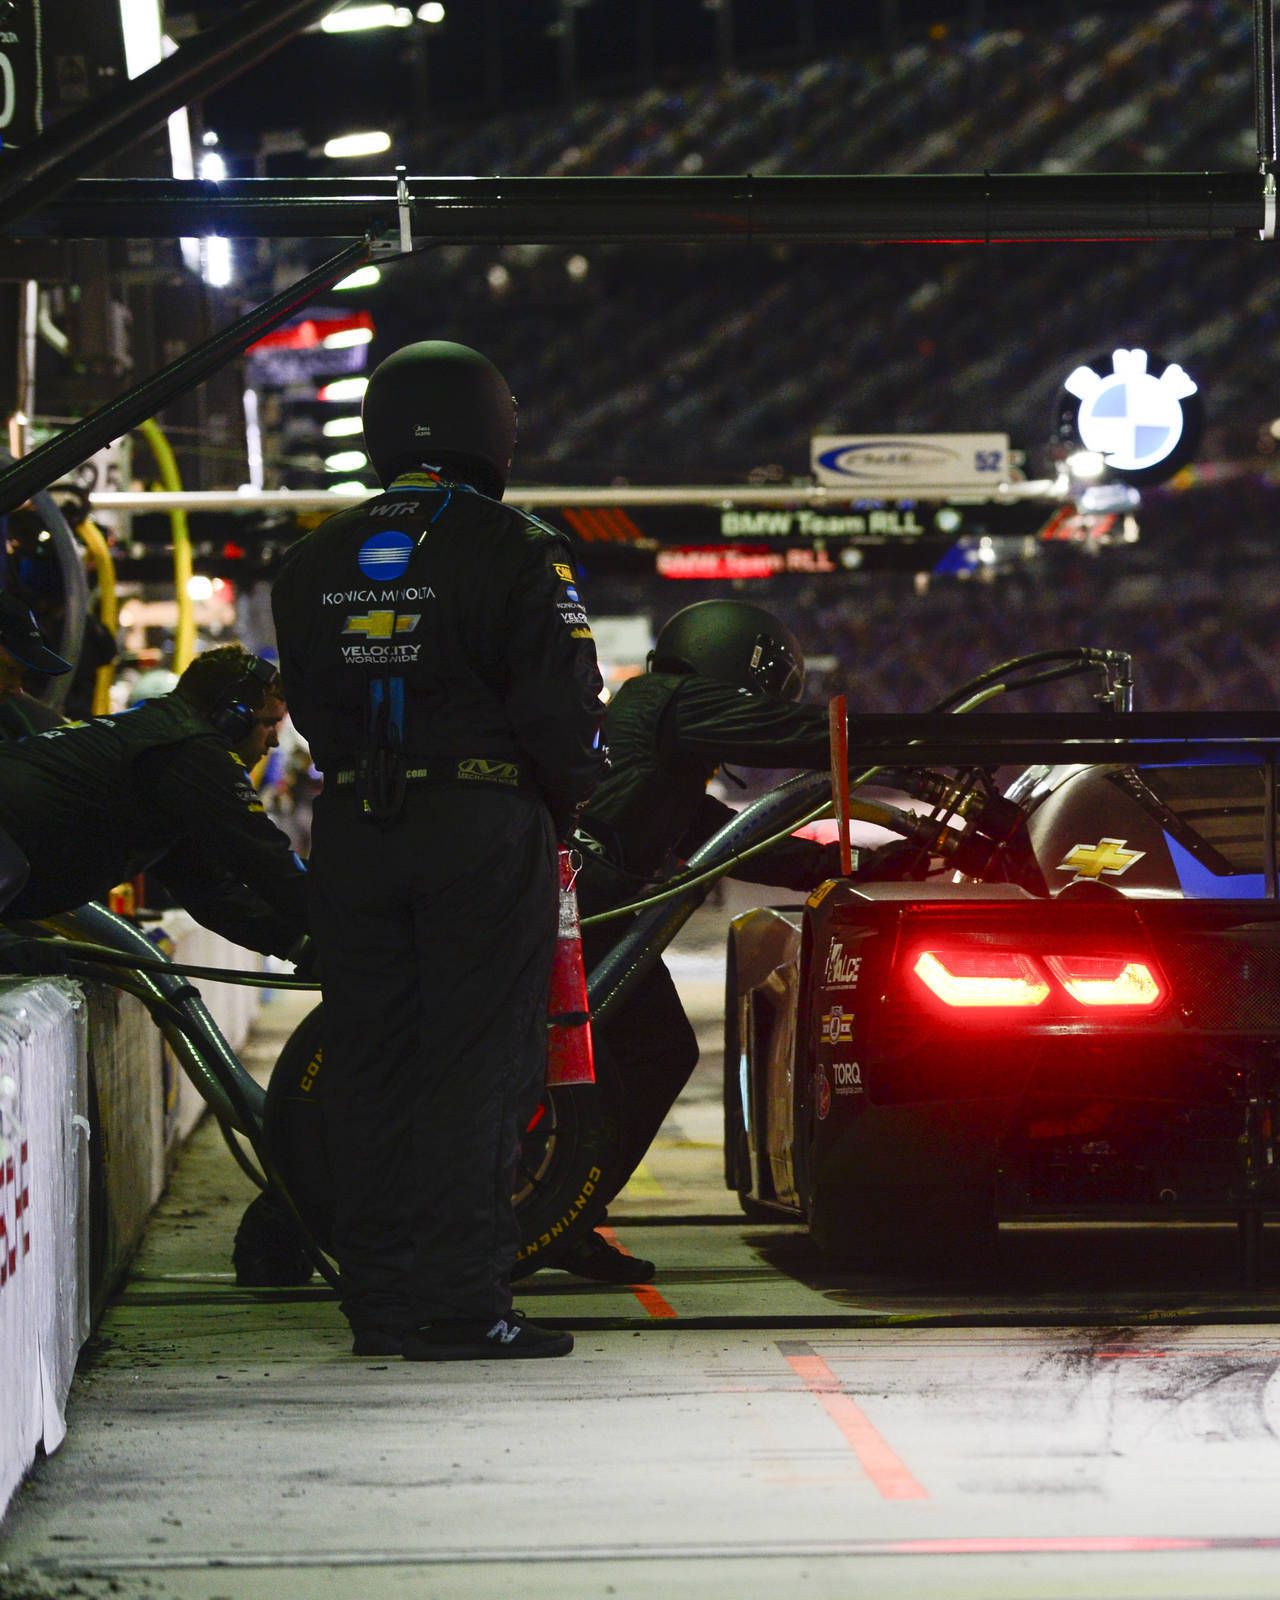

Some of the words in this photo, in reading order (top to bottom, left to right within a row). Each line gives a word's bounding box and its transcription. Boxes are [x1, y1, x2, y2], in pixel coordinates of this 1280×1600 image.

[973, 450, 1003, 472] 52
[369, 501, 421, 518] WTR
[721, 510, 793, 536] BMW
[795, 510, 866, 536] Team
[868, 510, 925, 536] RLL
[341, 644, 422, 658] VELOCITY
[833, 1062, 862, 1086] TORQ
